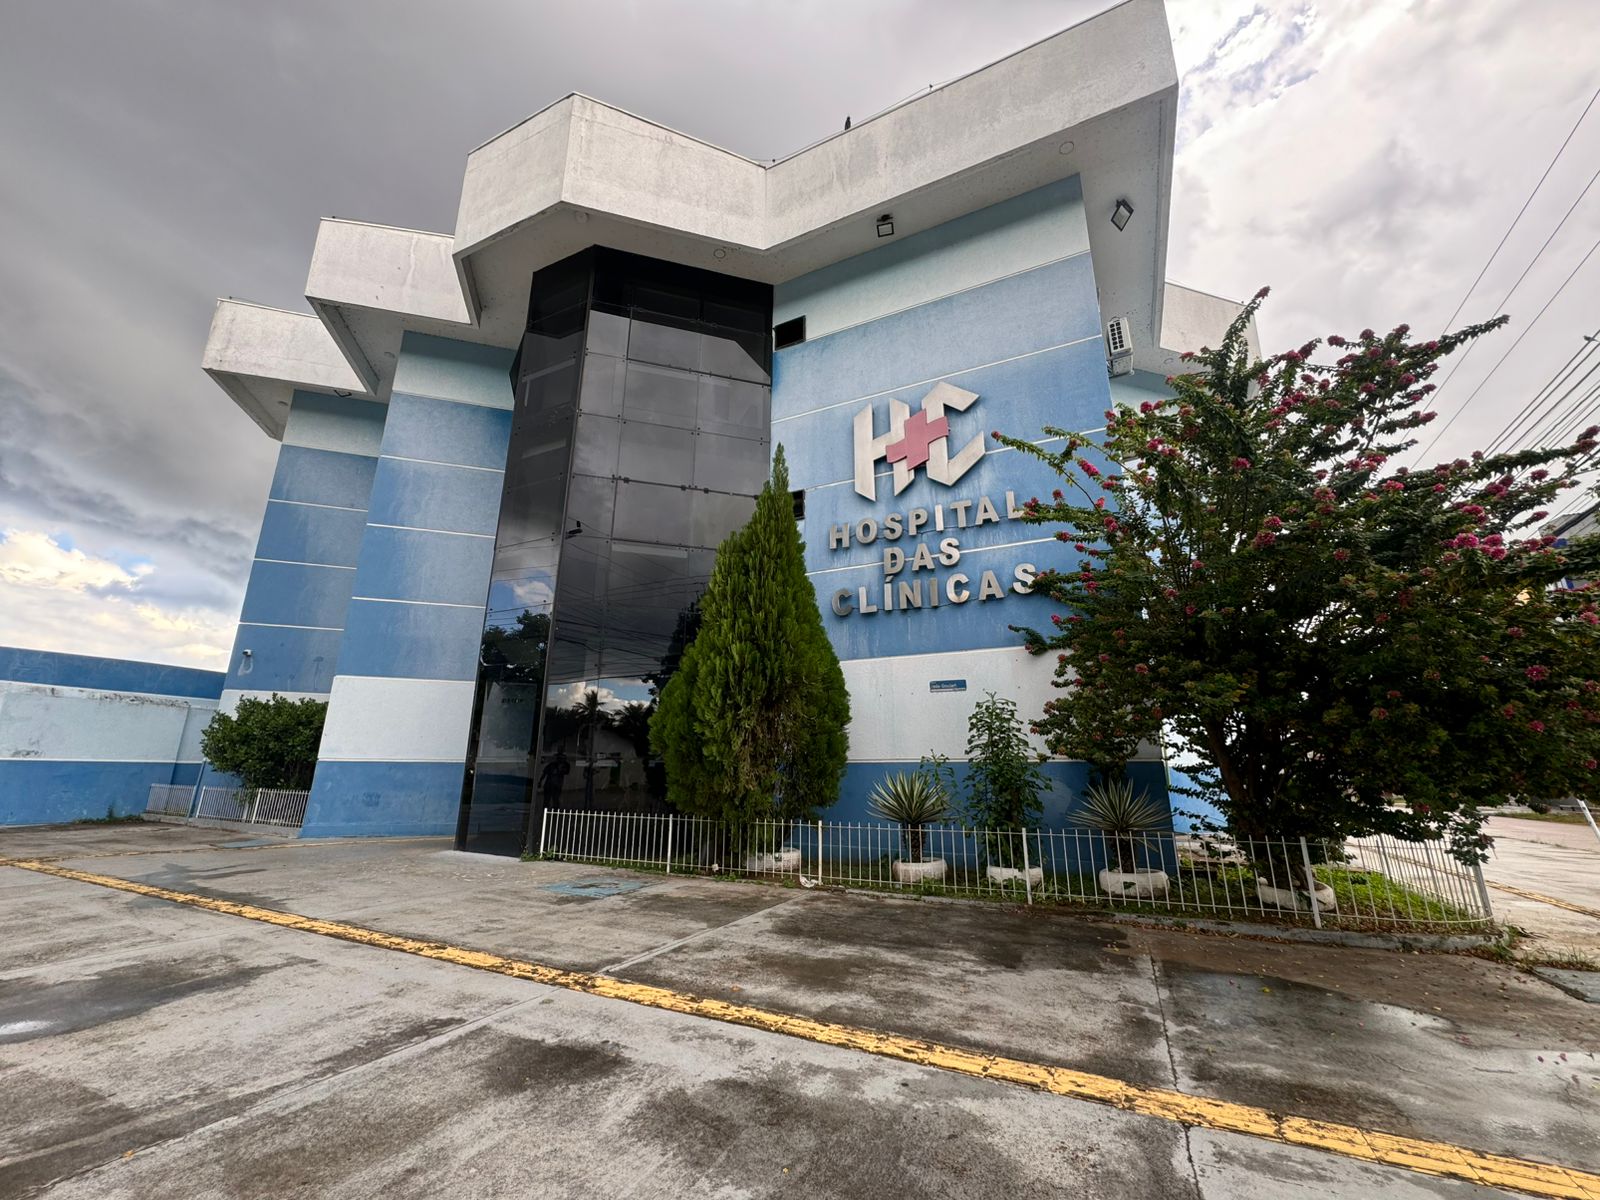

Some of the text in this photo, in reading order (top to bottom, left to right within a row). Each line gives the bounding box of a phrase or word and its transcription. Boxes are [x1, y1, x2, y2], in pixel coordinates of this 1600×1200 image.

[853, 382, 985, 502] HC
[829, 490, 1024, 549] HOSPITAL
[884, 538, 961, 575] DAS
[831, 563, 1037, 616] CLÍNICAS
